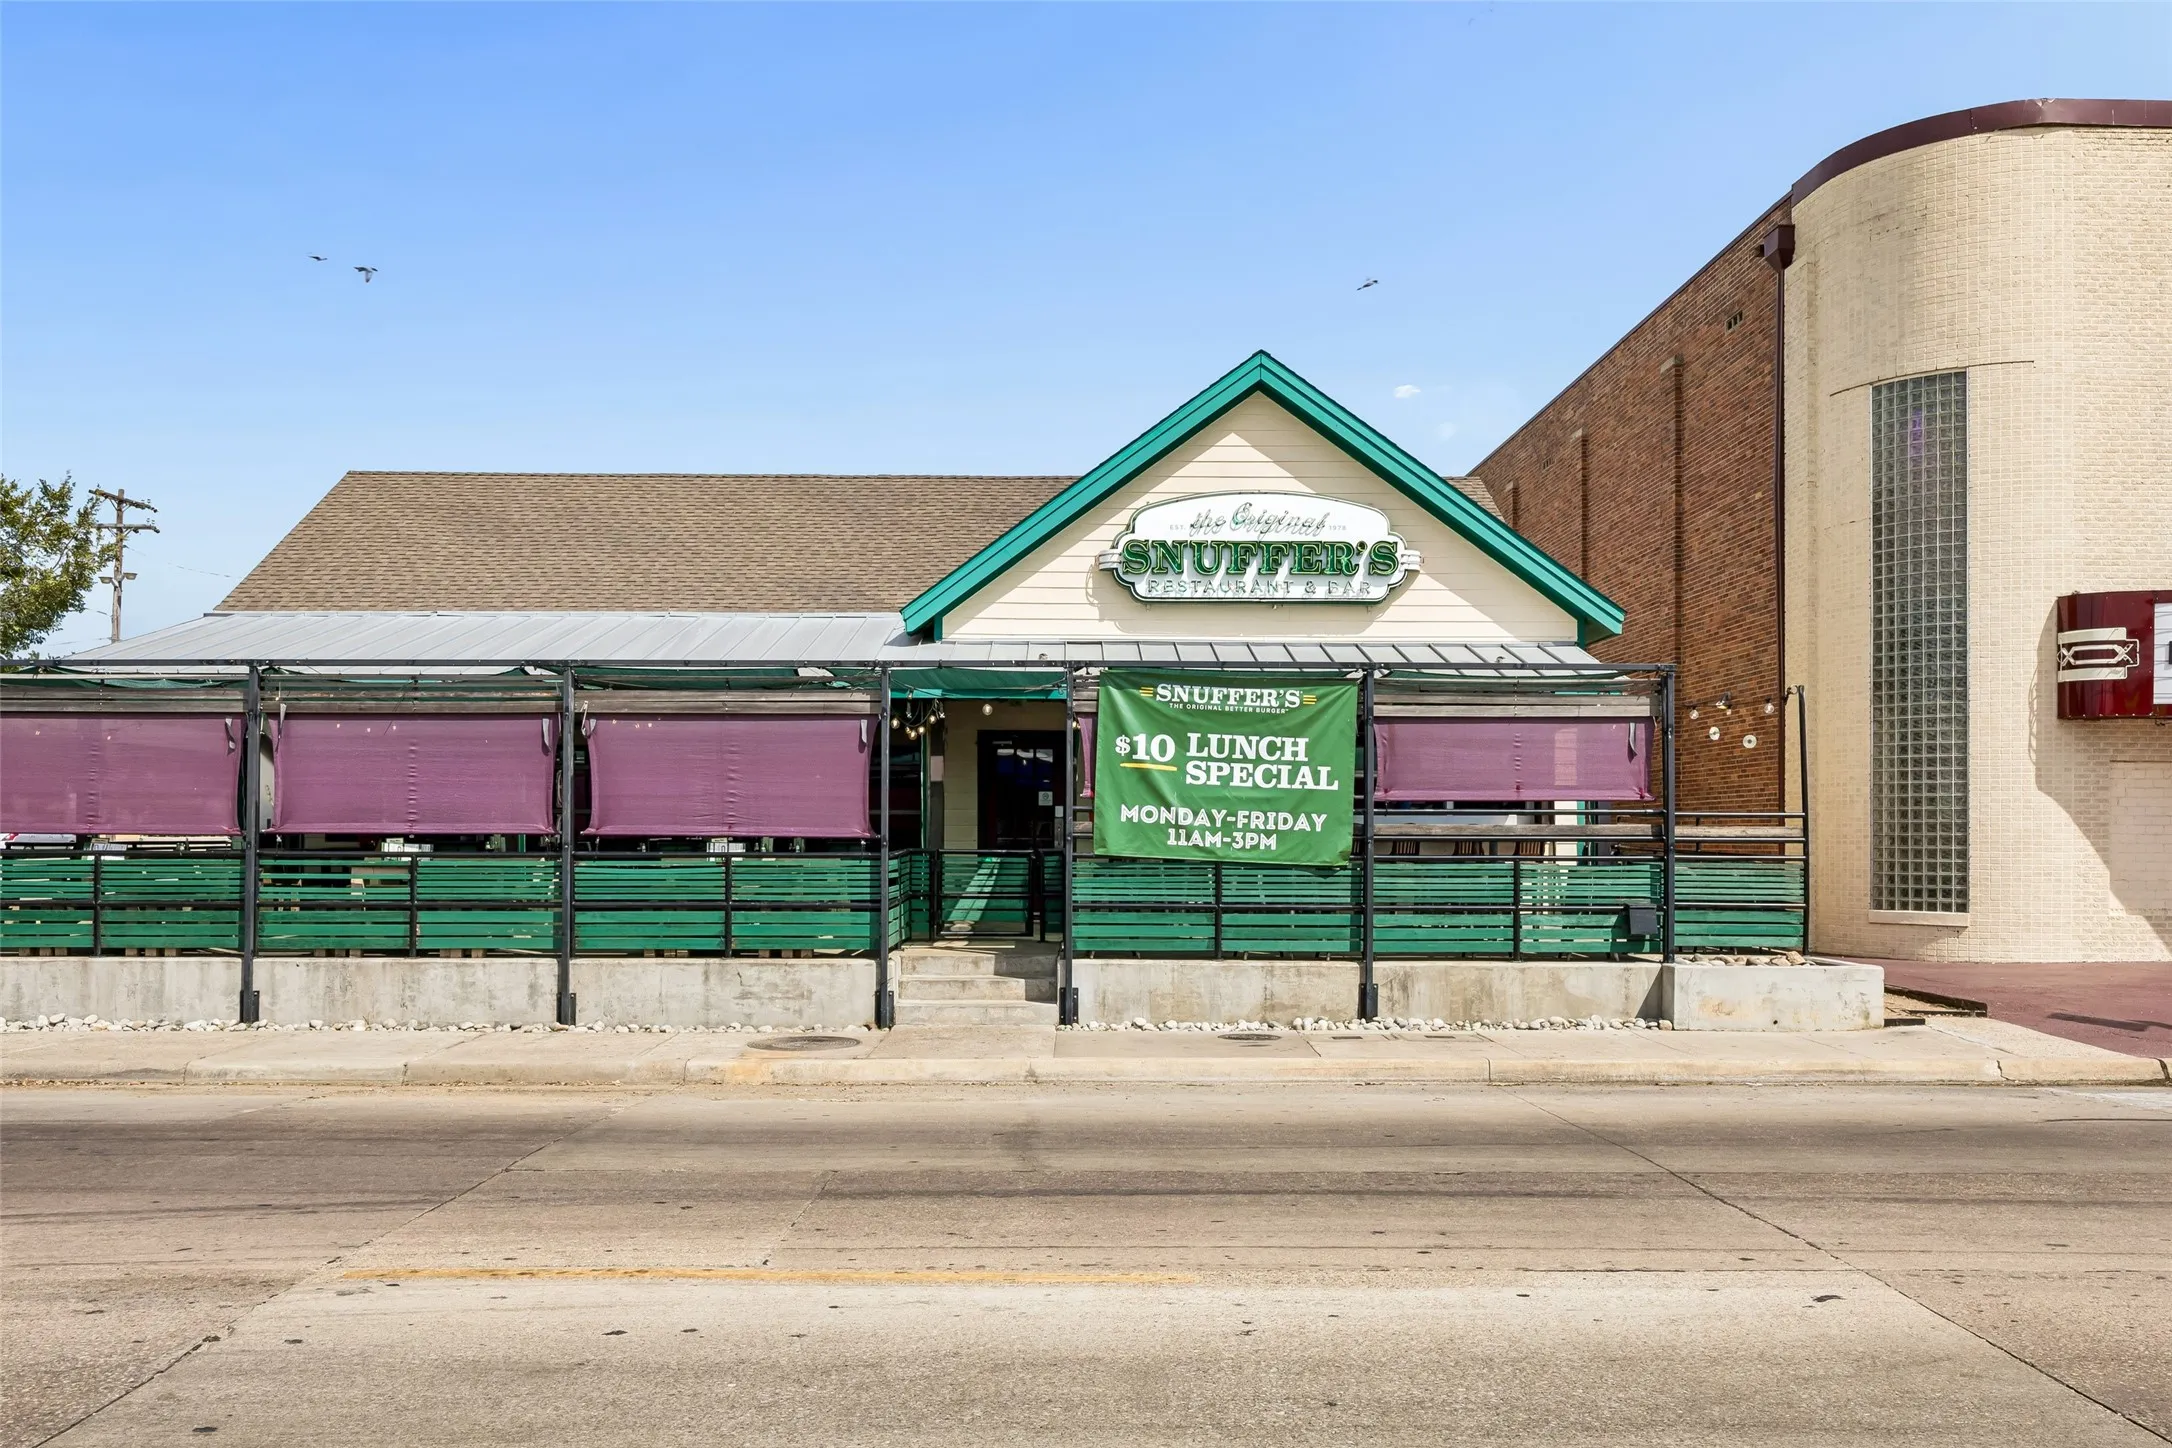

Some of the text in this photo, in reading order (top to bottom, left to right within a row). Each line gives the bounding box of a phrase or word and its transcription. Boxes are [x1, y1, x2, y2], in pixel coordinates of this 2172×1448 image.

[1189, 502, 1331, 535] the Original
[1122, 539, 1399, 576] SNUFFER'S
[1148, 579, 1371, 594] RESTAURANT & BAR
[1156, 683, 1301, 708] SNUFFER'S
[1115, 733, 1176, 762] $10
[1186, 732, 1309, 762] LUNCH
[1185, 761, 1339, 791] SPECIAL
[1120, 804, 1328, 832] MONDAY-FRIDAY
[1166, 828, 1277, 850] 11AM-3PM
